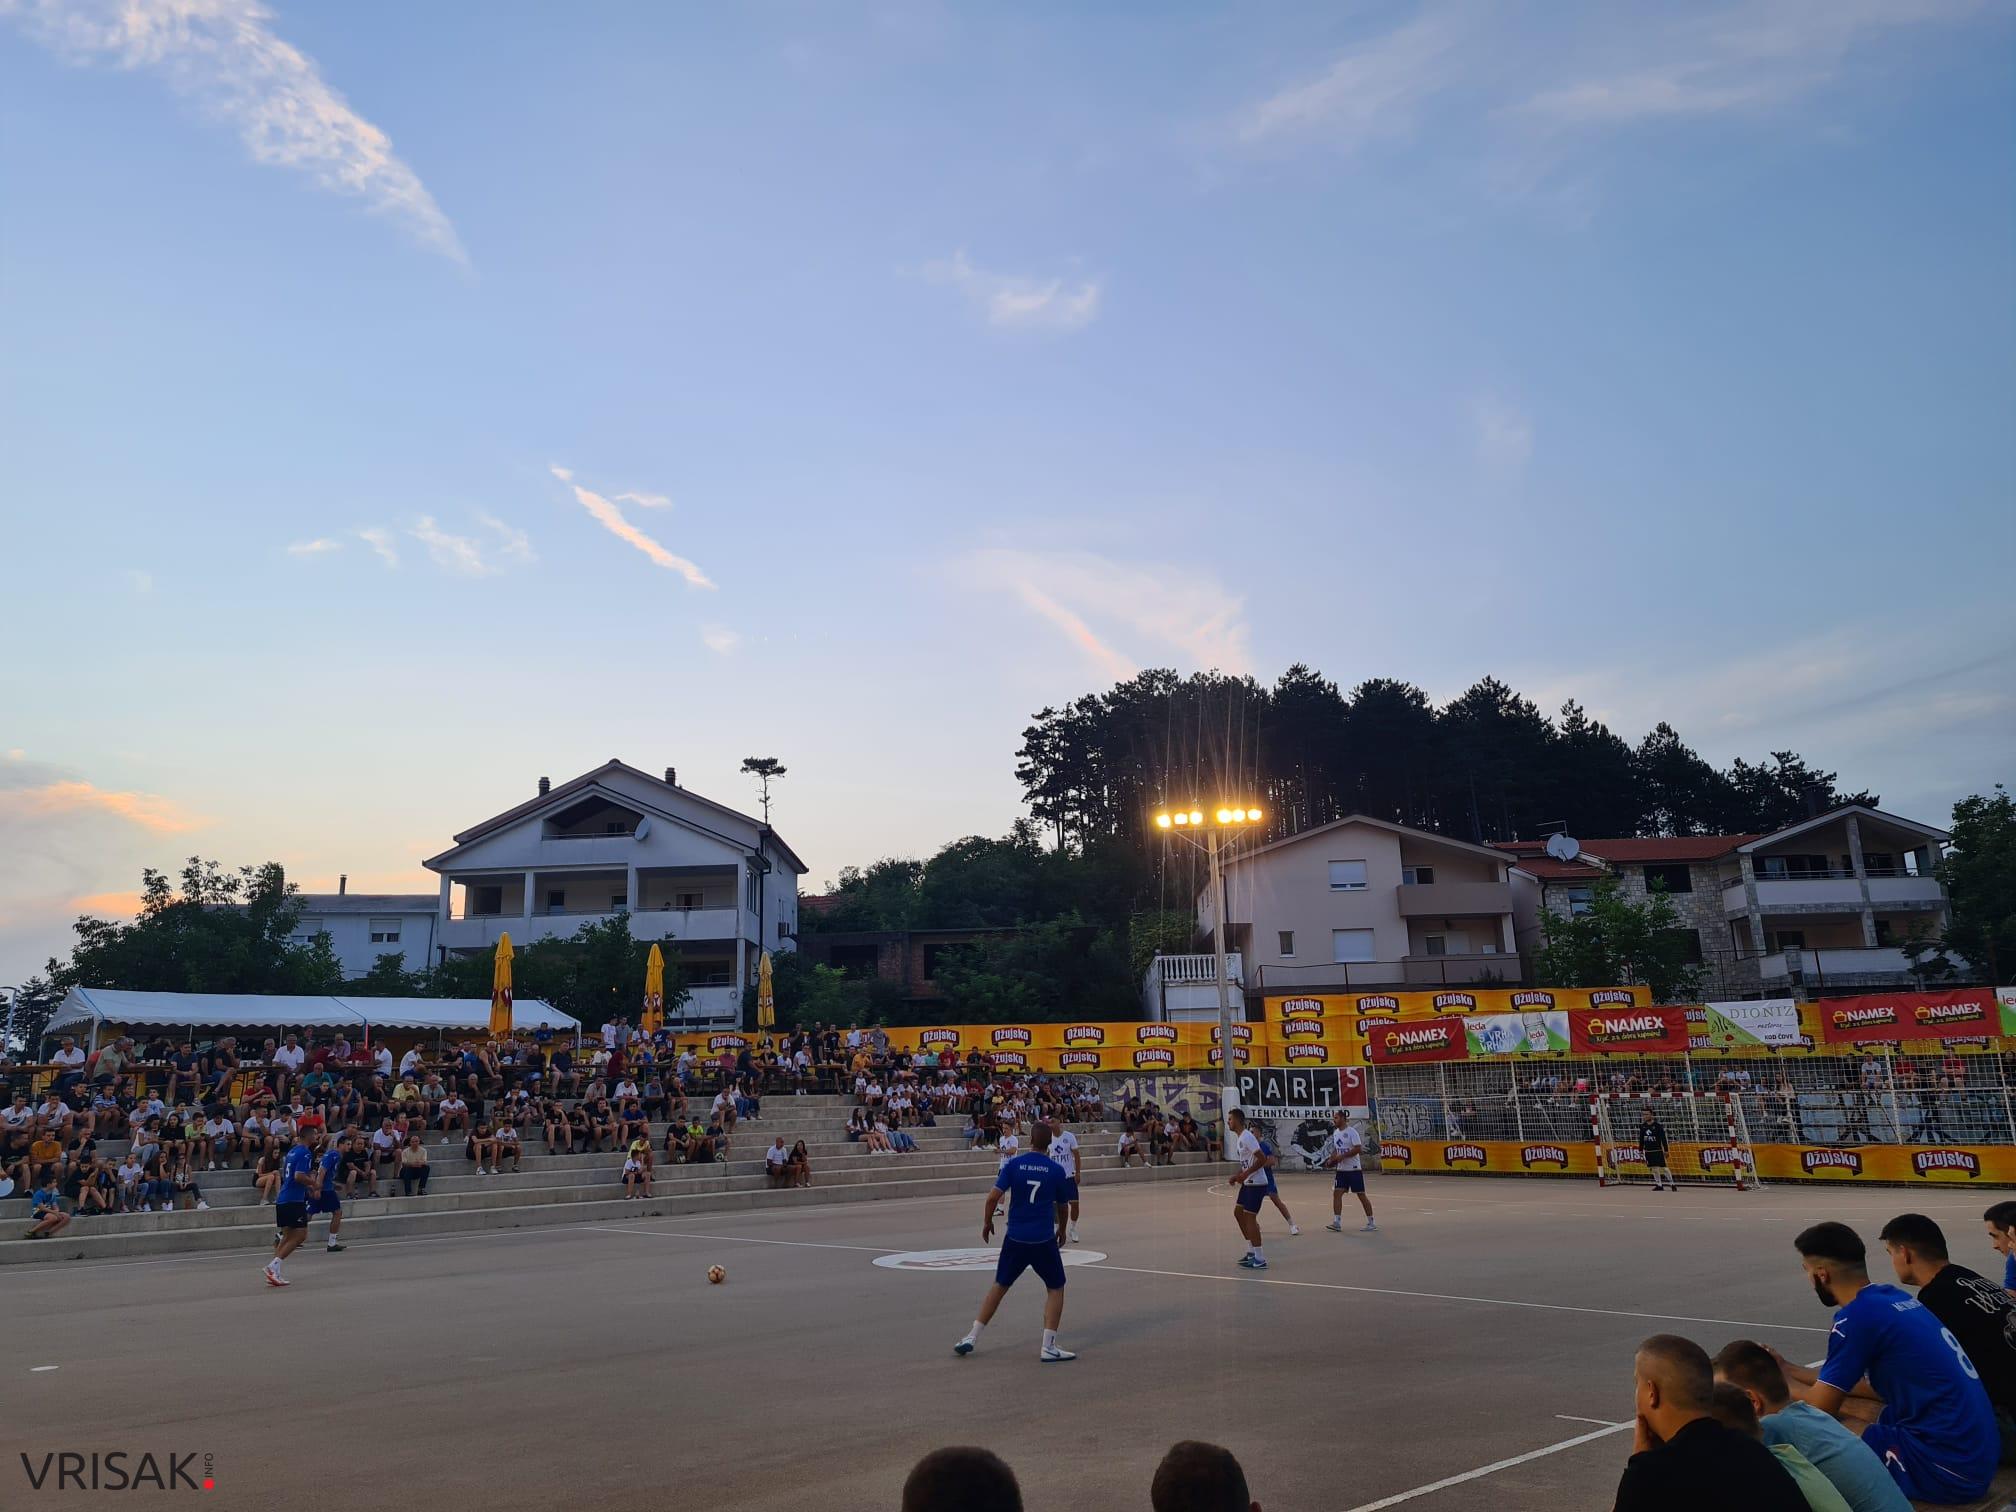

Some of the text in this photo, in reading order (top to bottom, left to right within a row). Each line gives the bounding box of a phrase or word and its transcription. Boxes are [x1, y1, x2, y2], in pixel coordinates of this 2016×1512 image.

[1360, 997, 1396, 1010] Ožujsko
[1436, 994, 1473, 1007] Ožujsko
[1514, 992, 1551, 1005] Ožujsko
[1593, 990, 1631, 1004] Ožujsko
[1284, 999, 1321, 1013] Ožujsko
[1729, 1005, 1794, 1019] DIONIZ
[1929, 1002, 1983, 1019] NAMEX
[1846, 1006, 1896, 1022] NAMEX
[1286, 1020, 1321, 1033] Ožujsko
[1467, 1021, 1487, 1031] leda
[1605, 1016, 1665, 1034] NAMEX
[923, 1031, 957, 1044] Ožujsko
[994, 1029, 1029, 1042] Ožujsko
[1067, 1026, 1102, 1039] Ožujsko
[1140, 1026, 1175, 1038] Ožujsko
[1399, 1027, 1449, 1046] NAMEX
[1529, 1027, 1545, 1038] leda
[1136, 1049, 1171, 1062] Ožujsko
[1289, 1045, 1325, 1058] Ožujsko
[1062, 1052, 1098, 1065] Ožujsko
[1251, 1107, 1300, 1118] TEHNIČKI
[1380, 1144, 1409, 1159] žujsko
[1447, 1145, 1484, 1160] Ožujsko
[1525, 1145, 1565, 1162] Ožujsko
[1806, 1150, 1857, 1167] Ožujsko
[1918, 1151, 1974, 1169] Ožujsko
[1026, 1179, 1041, 1204] 7
[1941, 1327, 1979, 1380] 8
